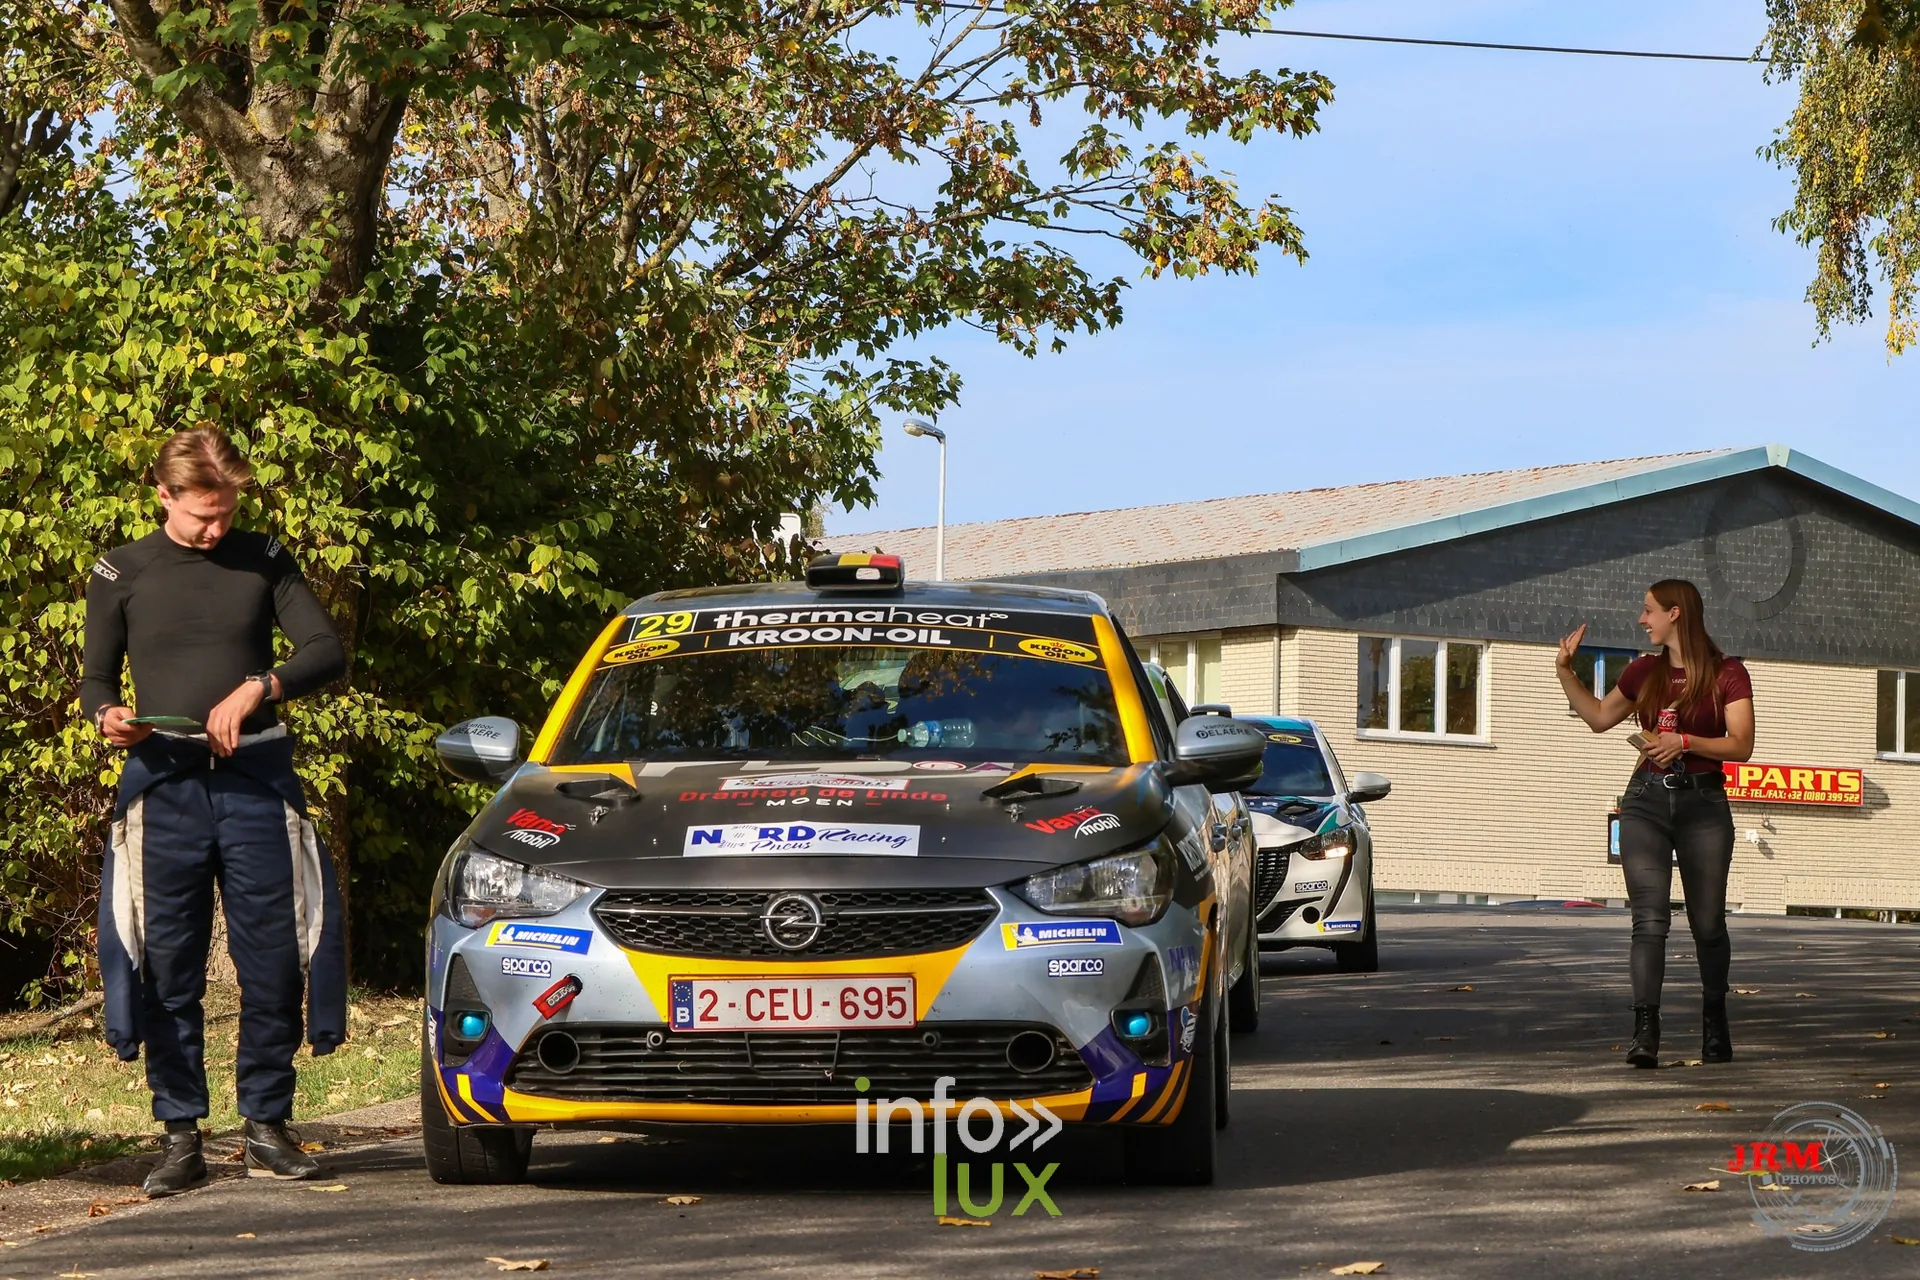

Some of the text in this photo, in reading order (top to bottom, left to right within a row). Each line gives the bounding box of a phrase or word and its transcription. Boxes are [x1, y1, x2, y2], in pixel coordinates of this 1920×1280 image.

[634, 611, 694, 639] 29
[728, 627, 951, 646] KROON-OIL
[613, 643, 669, 658] KROON
[627, 651, 652, 660] OIL
[1030, 643, 1086, 658] KROON
[1045, 651, 1069, 660] OIL
[679, 788, 948, 802] Dranken de Linde
[766, 797, 853, 807] MOEN
[1788, 790, 1802, 800] +32
[1803, 790, 1826, 801] (0)80
[1827, 792, 1842, 802] 399
[1843, 793, 1860, 803] 522
[1079, 816, 1121, 836] mobil
[510, 830, 555, 849] mobil
[818, 827, 912, 849] Racing
[748, 840, 813, 852] Pneus
[514, 930, 580, 946] MICHELIN
[1038, 928, 1107, 939] MICHELIN
[502, 957, 551, 975] sparco
[1048, 959, 1104, 976] sparco
[699, 986, 907, 1021] 2-CEU-695
[676, 1007, 690, 1022] B
